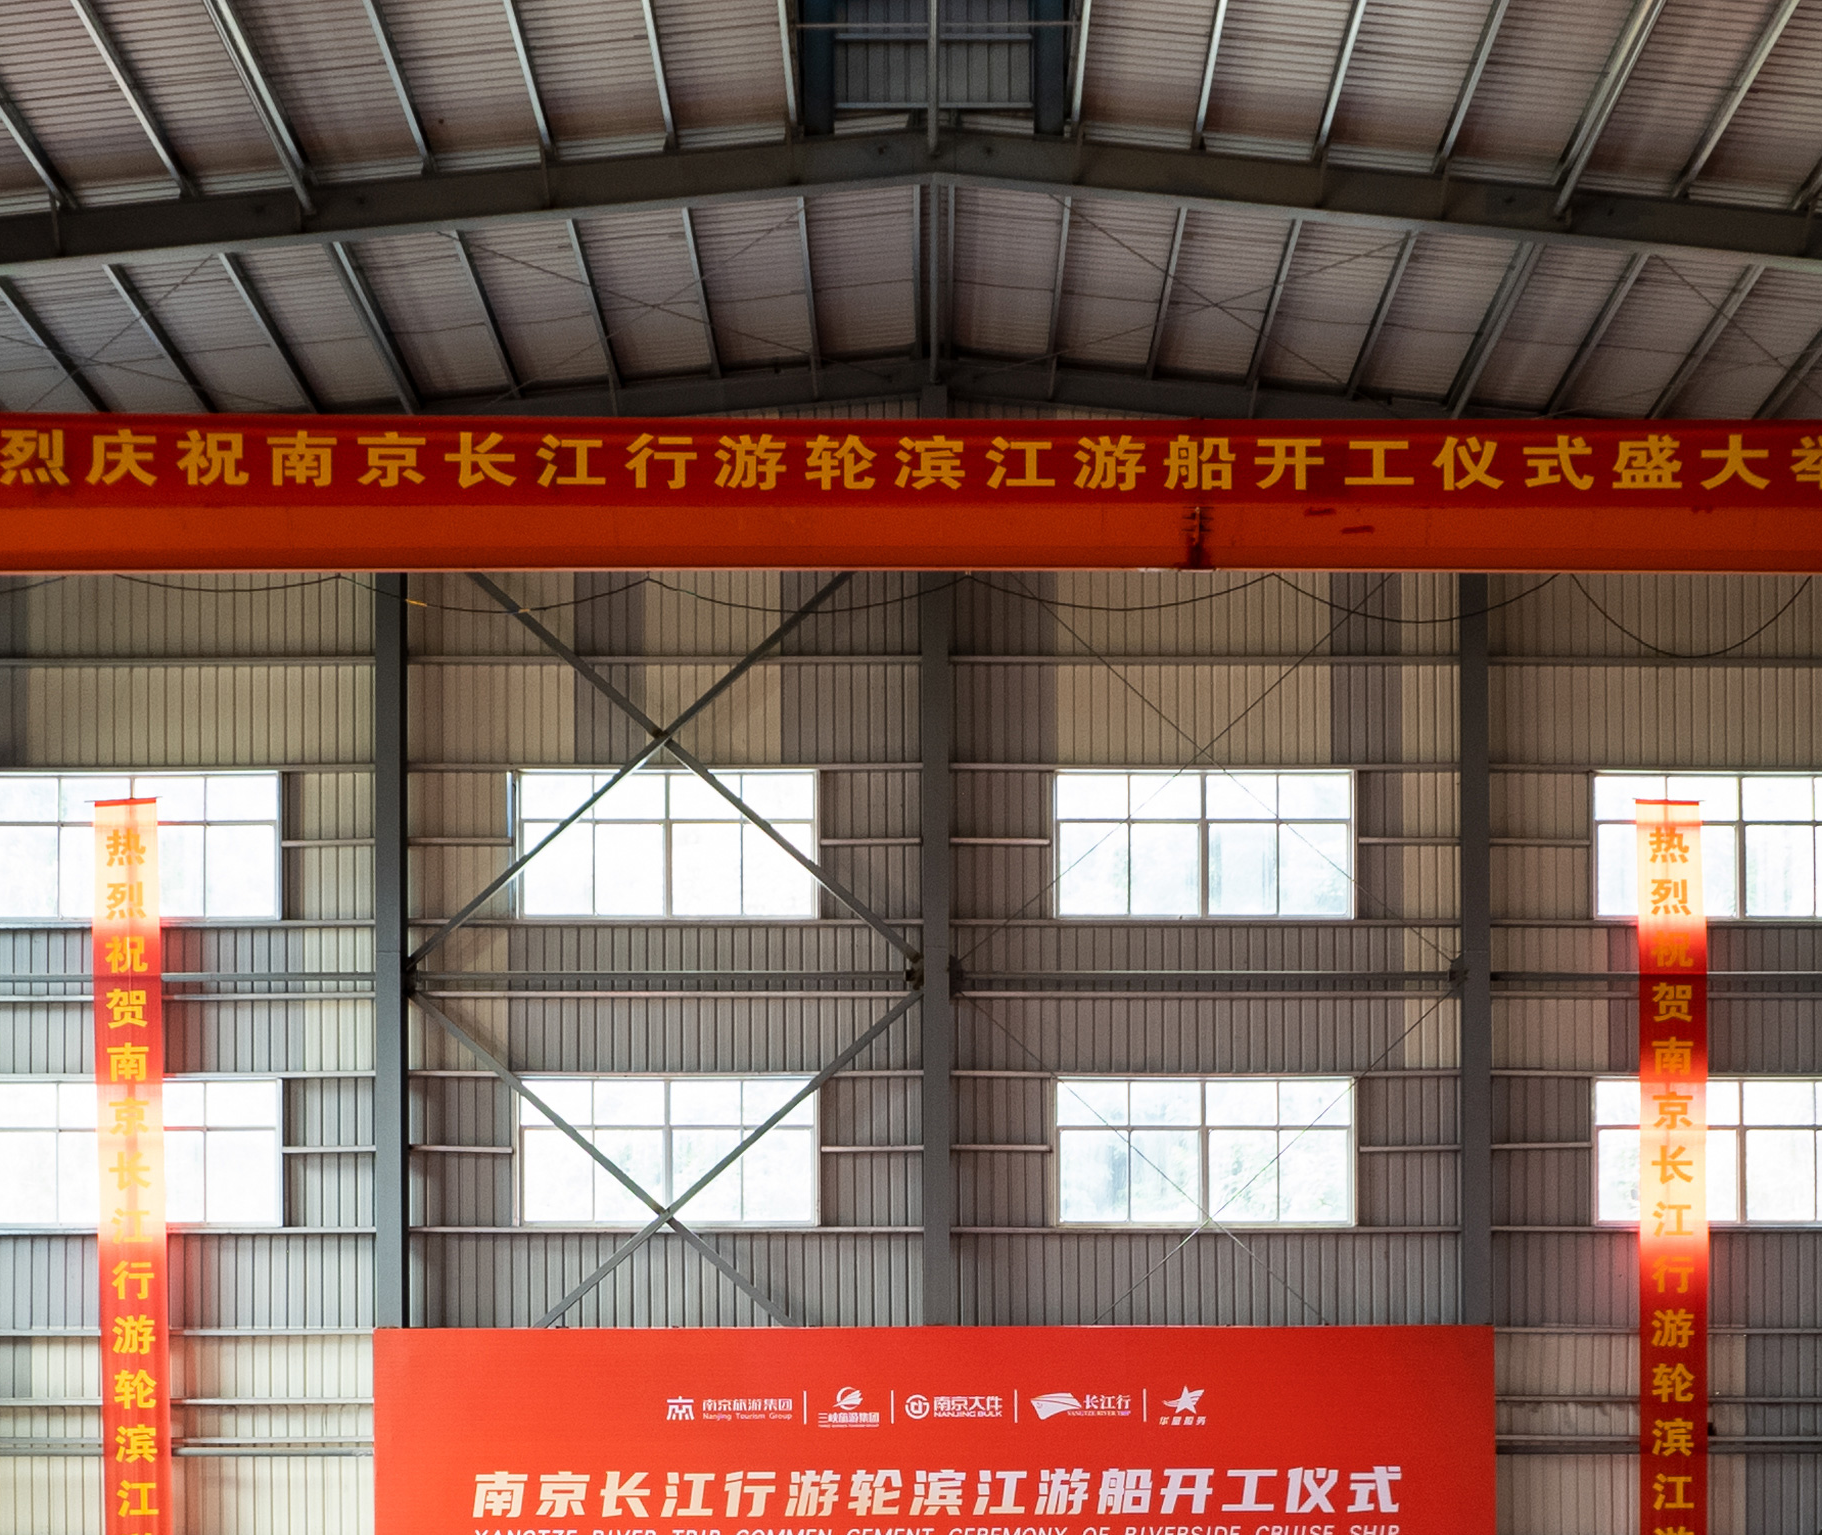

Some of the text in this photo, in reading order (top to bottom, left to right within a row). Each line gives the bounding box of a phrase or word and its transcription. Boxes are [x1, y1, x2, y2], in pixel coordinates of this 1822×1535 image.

[702, 1398, 792, 1411] 南京旅游集团
[934, 1396, 1003, 1411] 南京大件
[1083, 1394, 1131, 1409] 长江行
[702, 1412, 792, 1422] Nanjing Tourism Group
[818, 1412, 879, 1424] 三峡旅游集团
[472, 1466, 1402, 1519] 南京长江行游轮滨江游船开工仪式
